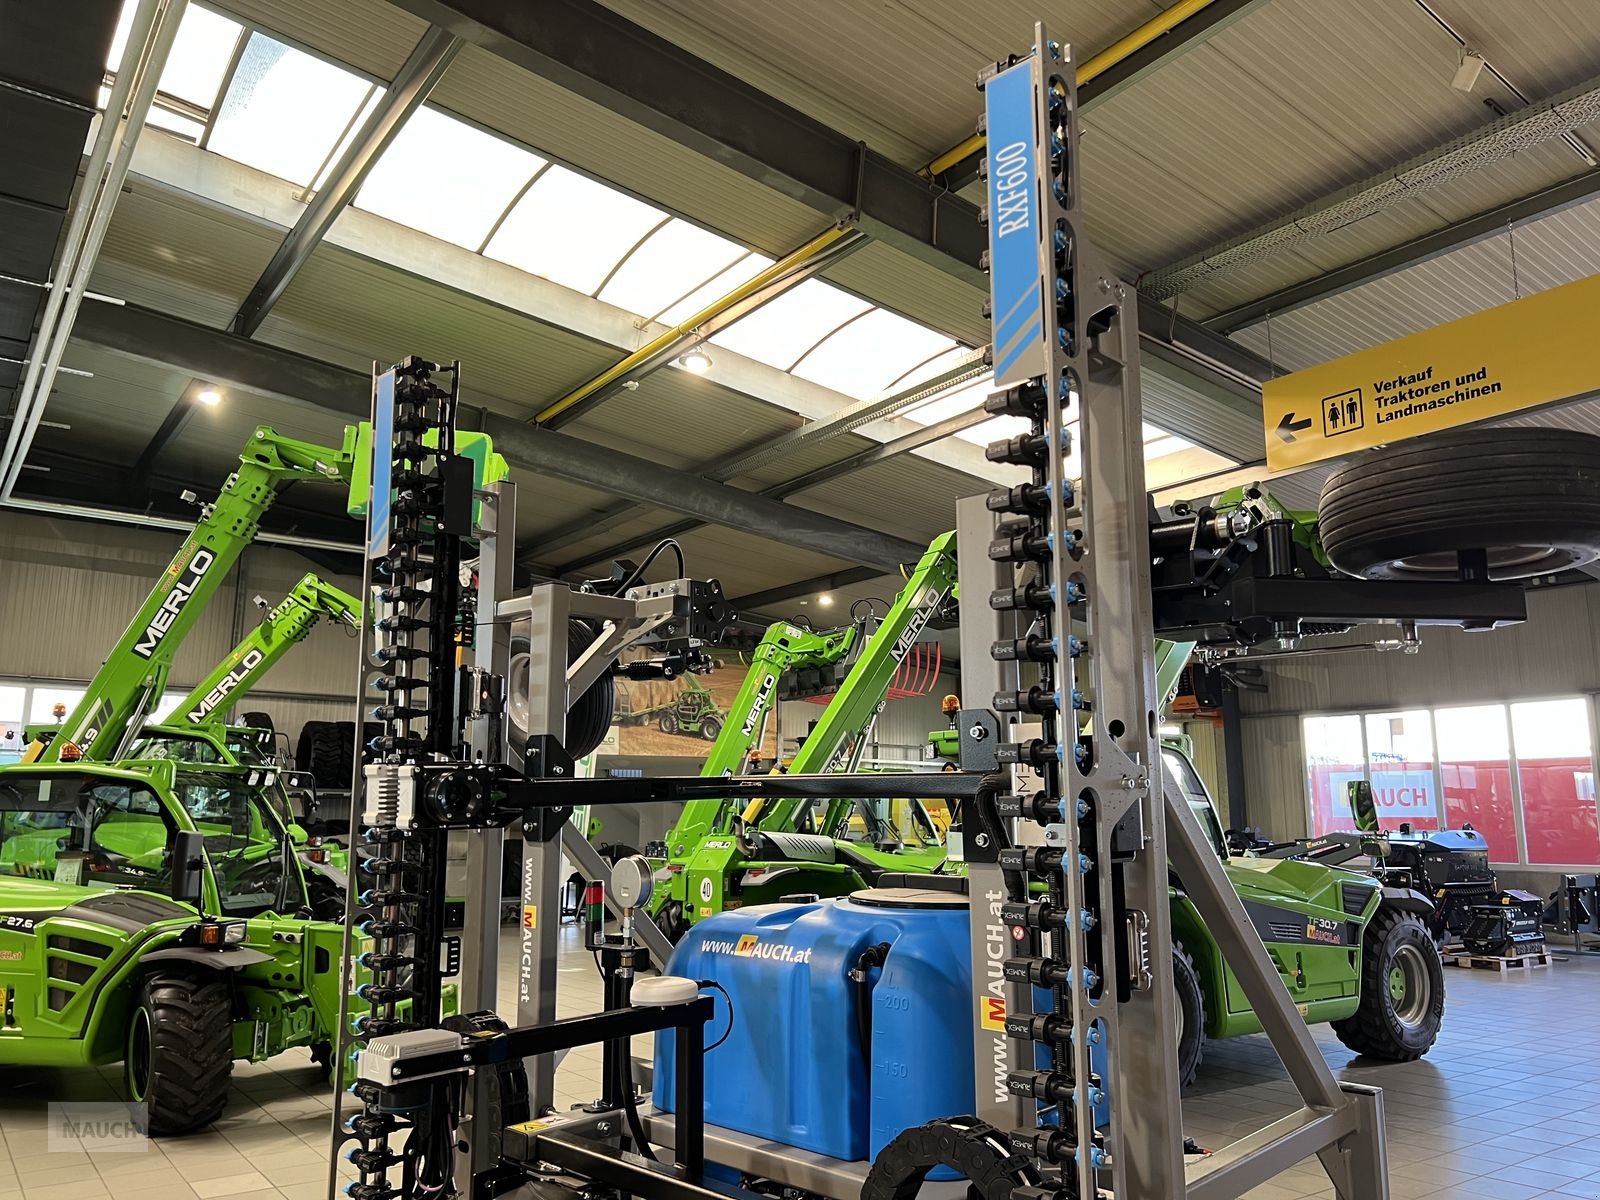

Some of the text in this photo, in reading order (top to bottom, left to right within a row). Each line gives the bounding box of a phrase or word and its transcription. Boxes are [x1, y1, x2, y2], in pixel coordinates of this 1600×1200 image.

[996, 141, 1029, 238] RXF600
[1373, 366, 1433, 394] Verkauf
[1374, 366, 1487, 408] Traktoren und
[1376, 382, 1502, 424] Landmaschinen
[135, 550, 213, 657] MERLO
[891, 589, 940, 662] MERLO
[188, 650, 262, 723] MERLO
[741, 675, 775, 736] MERLO
[704, 841, 732, 849] MERLO
[702, 883, 711, 898] 40
[521, 858, 533, 1003] www.MAUCH.at
[1307, 916, 1338, 930] TF30.7
[701, 938, 812, 964] www.MAUCH.at
[884, 995, 910, 1012] 200
[986, 890, 1008, 1103] www.MAUCH.at
[884, 1060, 908, 1079] 150
